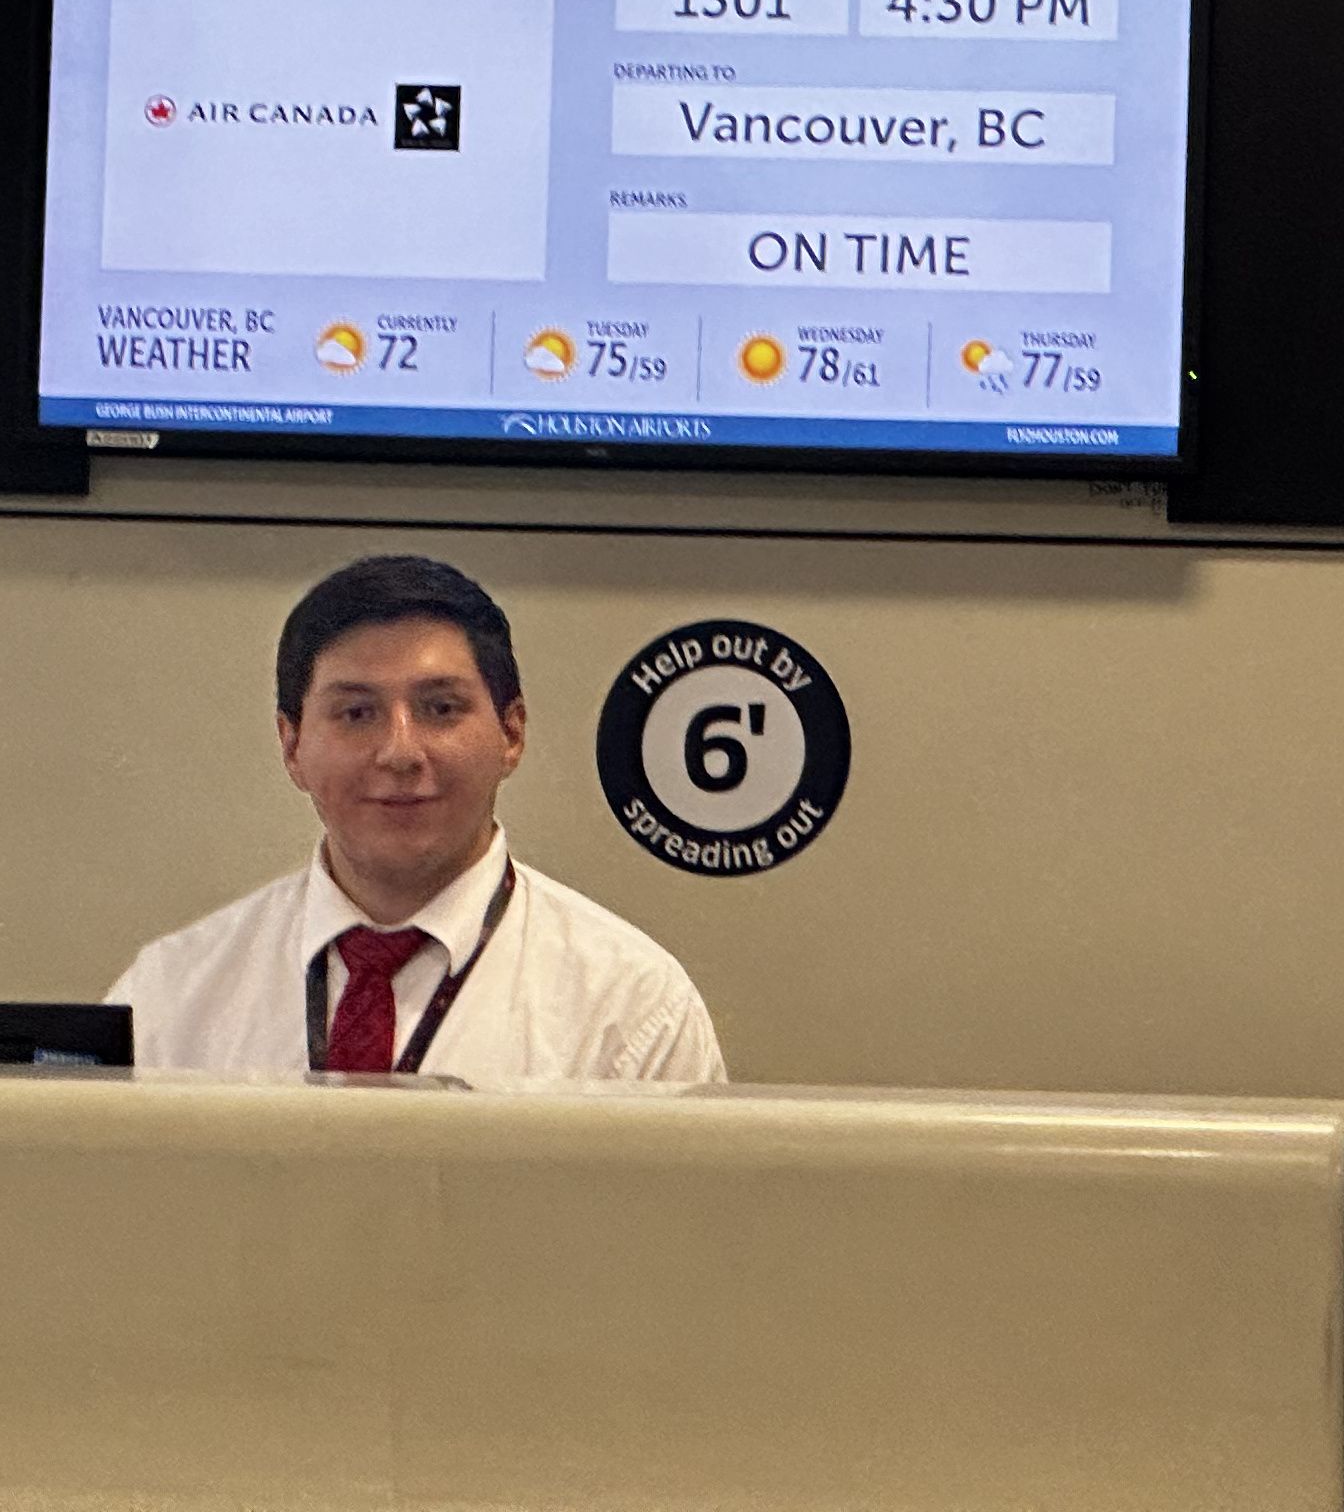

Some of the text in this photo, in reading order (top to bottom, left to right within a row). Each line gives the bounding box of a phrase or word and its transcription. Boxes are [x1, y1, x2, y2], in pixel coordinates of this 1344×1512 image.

[613, 62, 736, 81] DEPARTING TO
[188, 102, 380, 126] AIR CANADA
[678, 101, 1047, 153] Vancouver, BC
[609, 191, 688, 209] REMARKS
[748, 231, 971, 276] ON TIME
[97, 304, 276, 334] VANCOUVER, BC
[377, 313, 458, 333] CURRENTLY
[586, 320, 650, 339] TUESDAY
[797, 326, 886, 344] WEDNESDAY
[97, 335, 252, 372] WEATHER
[377, 334, 418, 371] 72
[1020, 330, 1096, 349] THURSDAY
[587, 340, 667, 383] 75/59
[798, 346, 881, 387] 78/61
[1022, 350, 1102, 392] 77/59
[95, 401, 142, 420] GEORGE
[143, 403, 174, 421] BUSH
[284, 408, 335, 425] AIRPORT
[538, 414, 712, 439] HOUSTON AIRPORTS
[631, 634, 813, 695] Help out by
[683, 702, 766, 793] 6'
[622, 797, 824, 868] spreading out
